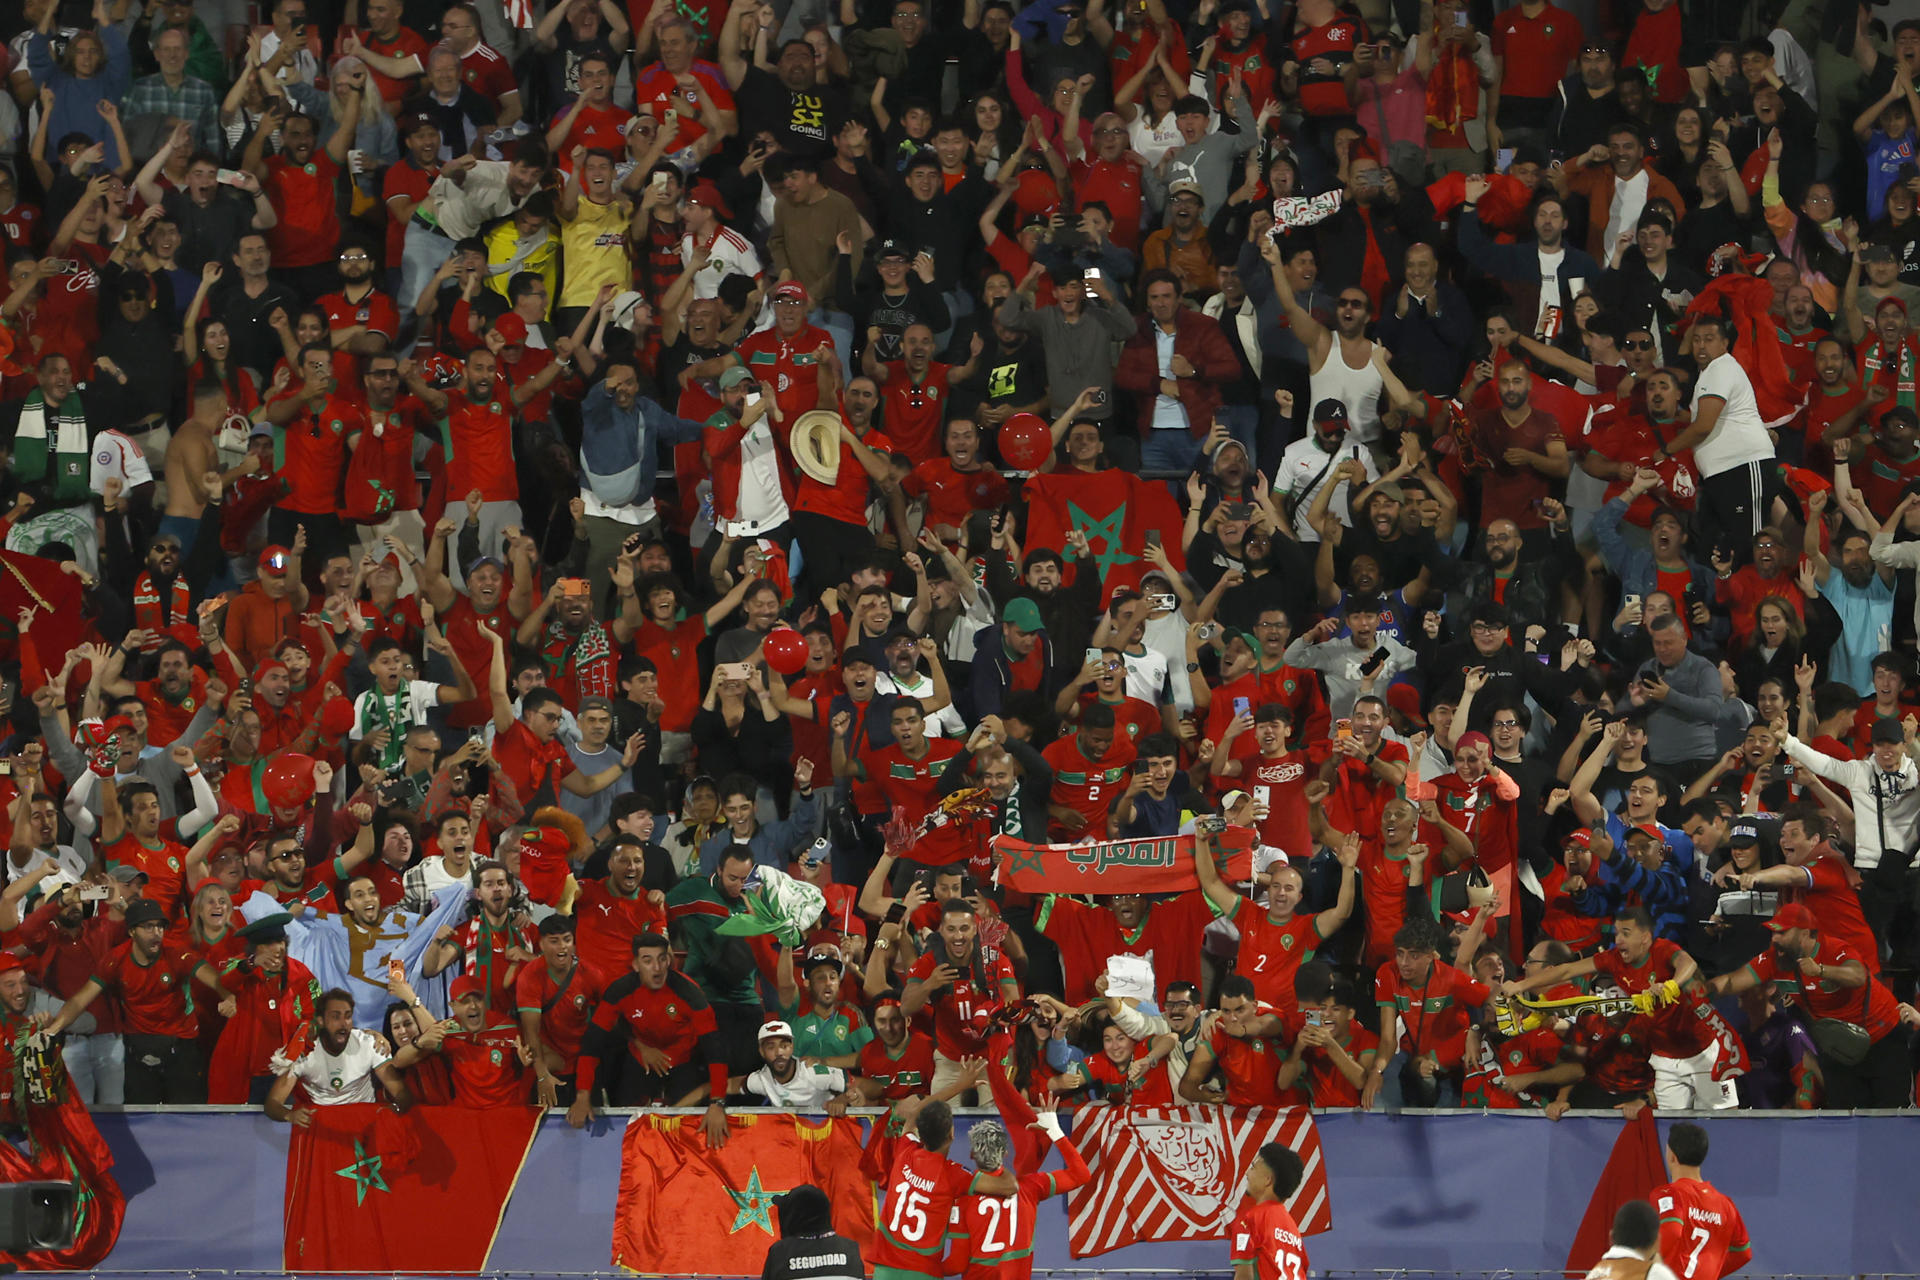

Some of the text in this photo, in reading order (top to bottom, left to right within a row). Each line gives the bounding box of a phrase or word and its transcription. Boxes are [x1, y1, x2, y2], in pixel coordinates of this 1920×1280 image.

[790, 124, 823, 136] GOING
[1087, 786, 1100, 801] 2
[1464, 812, 1475, 833] 7
[1253, 954, 1267, 972] 2
[958, 1000, 972, 1021] 11
[889, 1181, 930, 1242] 15
[1688, 1206, 1722, 1226] MAAMMA
[977, 1194, 1018, 1253] 21
[789, 1253, 847, 1271] SEGURIDAD
[1684, 1227, 1709, 1279] 7
[1274, 1249, 1302, 1280] 17
